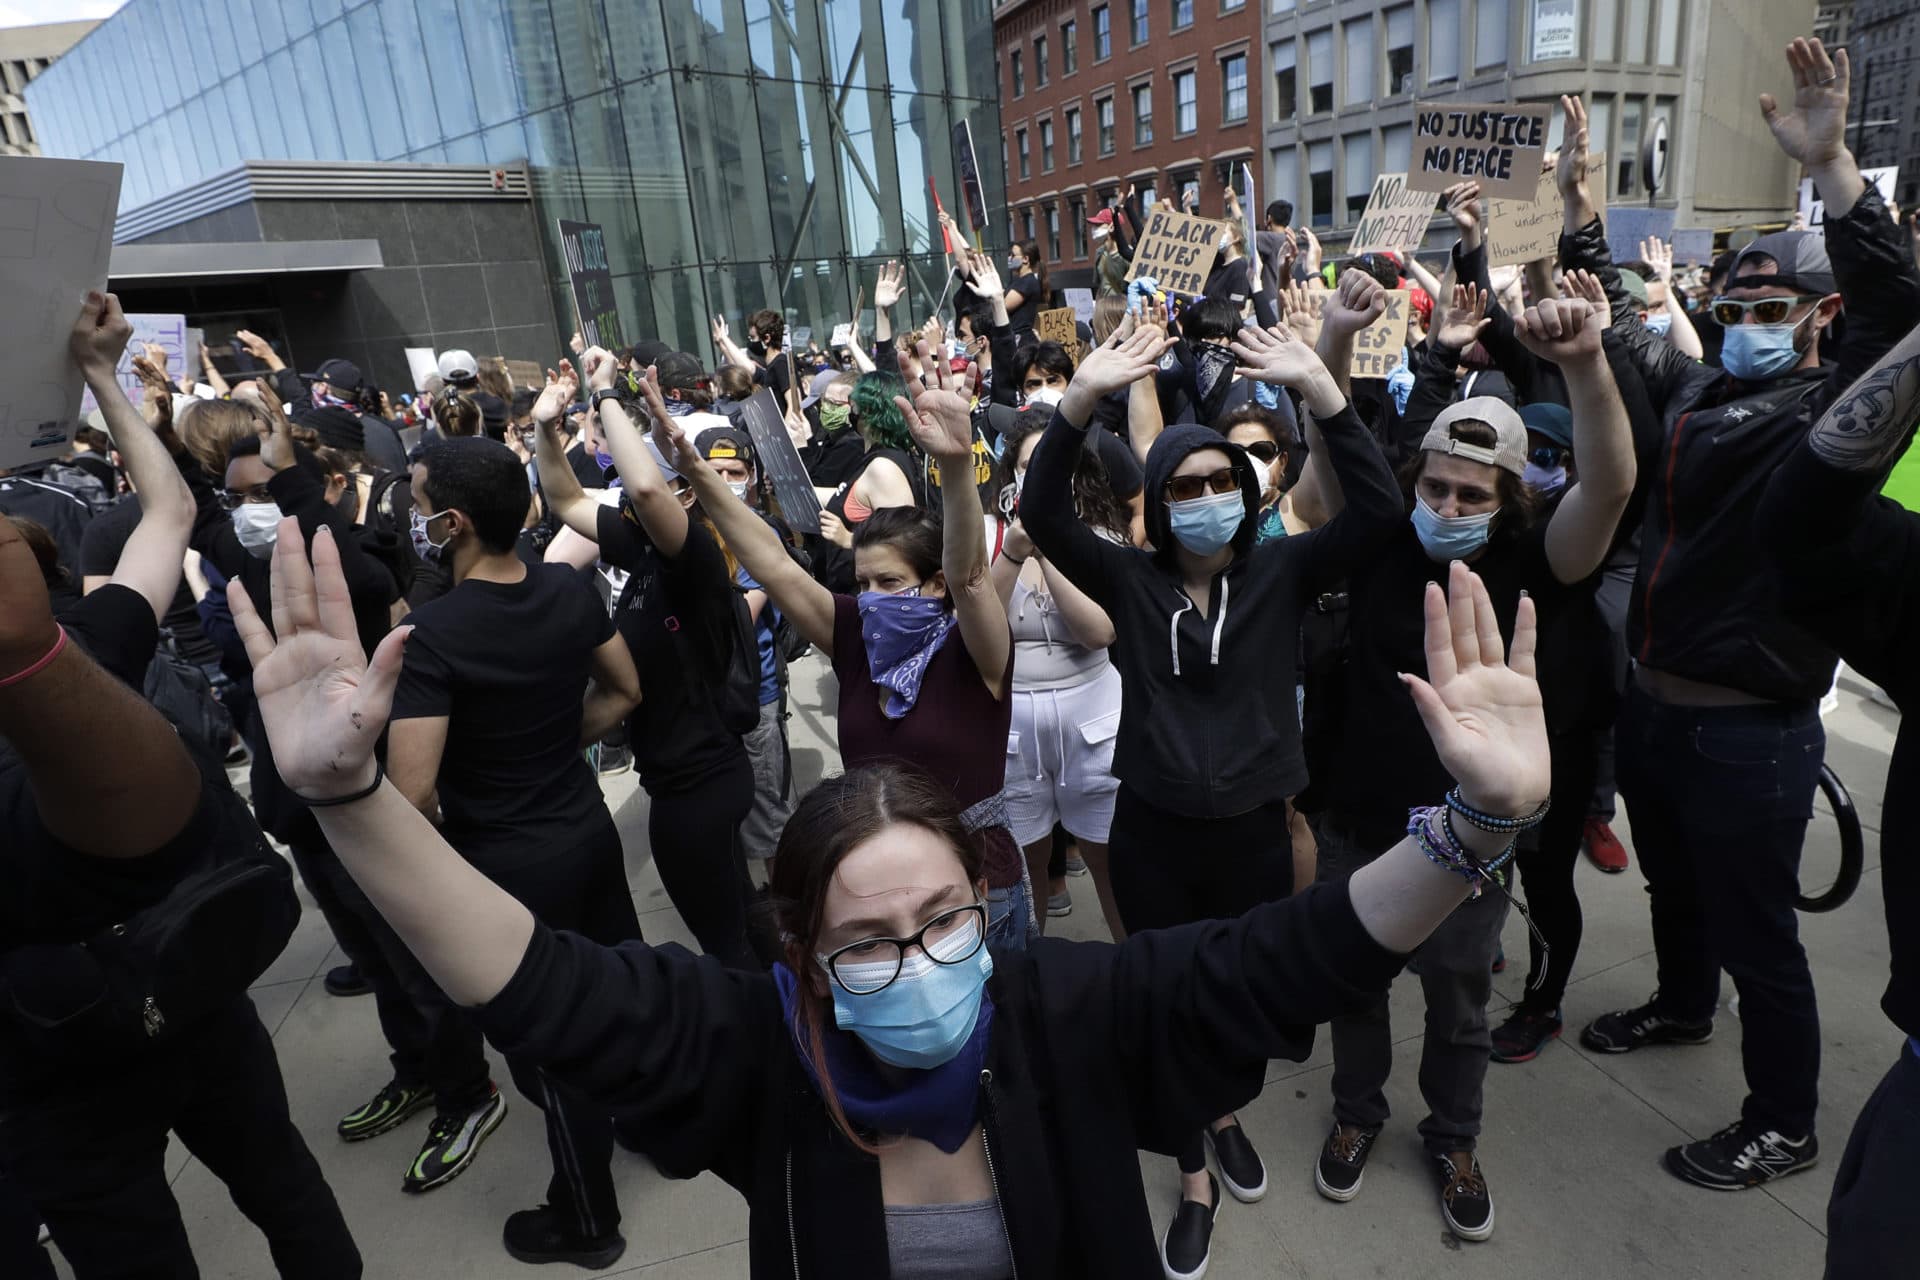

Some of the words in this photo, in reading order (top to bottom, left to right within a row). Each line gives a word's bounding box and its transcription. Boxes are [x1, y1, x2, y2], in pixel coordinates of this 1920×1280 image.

[1418, 112, 1444, 136] NO
[1447, 110, 1543, 147] JUSTICE
[1422, 146, 1451, 172] NO
[1453, 146, 1513, 180] PEACE
[1369, 177, 1402, 210] NO
[1149, 213, 1217, 246] BLACK
[1354, 217, 1385, 249] NO
[1376, 214, 1430, 247] PEACE
[564, 233, 584, 274] NO
[1141, 238, 1201, 267] LIVES
